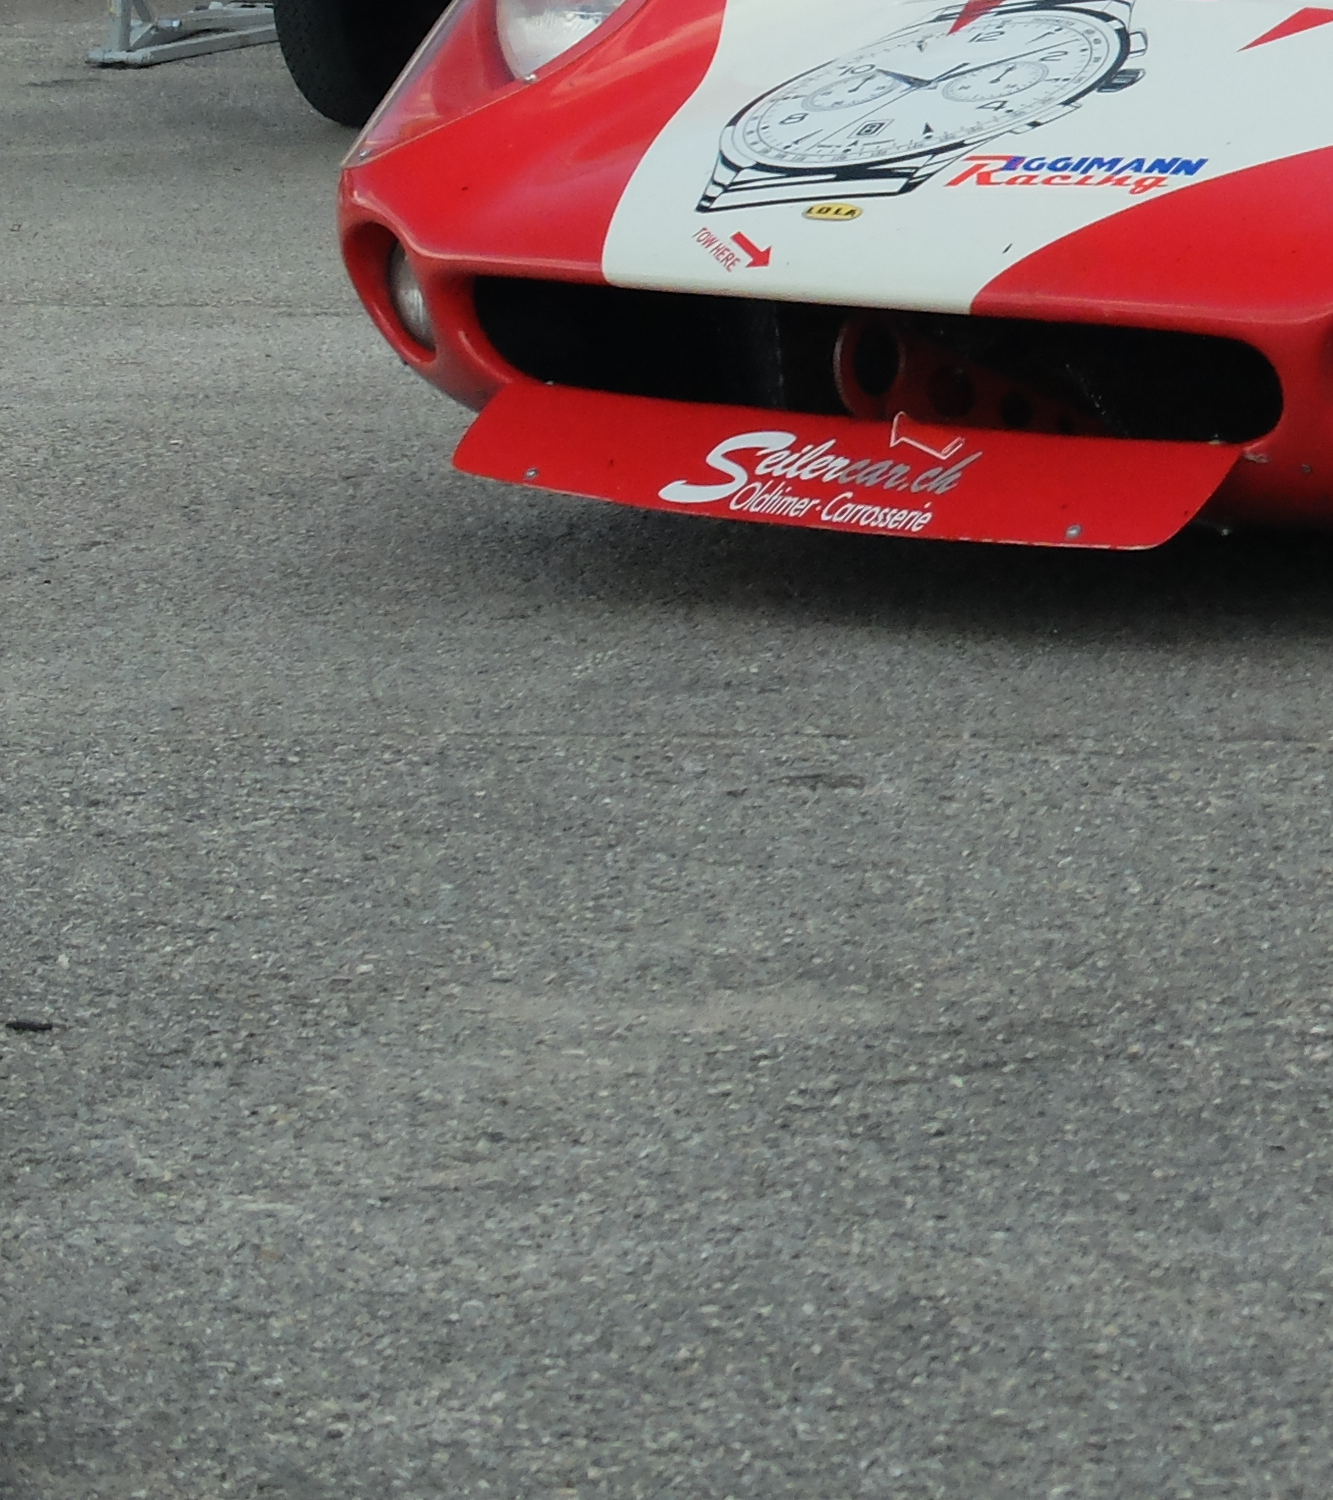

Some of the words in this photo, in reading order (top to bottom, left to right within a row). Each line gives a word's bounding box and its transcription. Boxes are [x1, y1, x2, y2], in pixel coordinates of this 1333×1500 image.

[943, 155, 1169, 195] Racing
[806, 206, 857, 217] LOLA
[692, 227, 719, 249] TOW
[710, 242, 741, 273] HERE
[729, 480, 820, 518] Oldtimer
